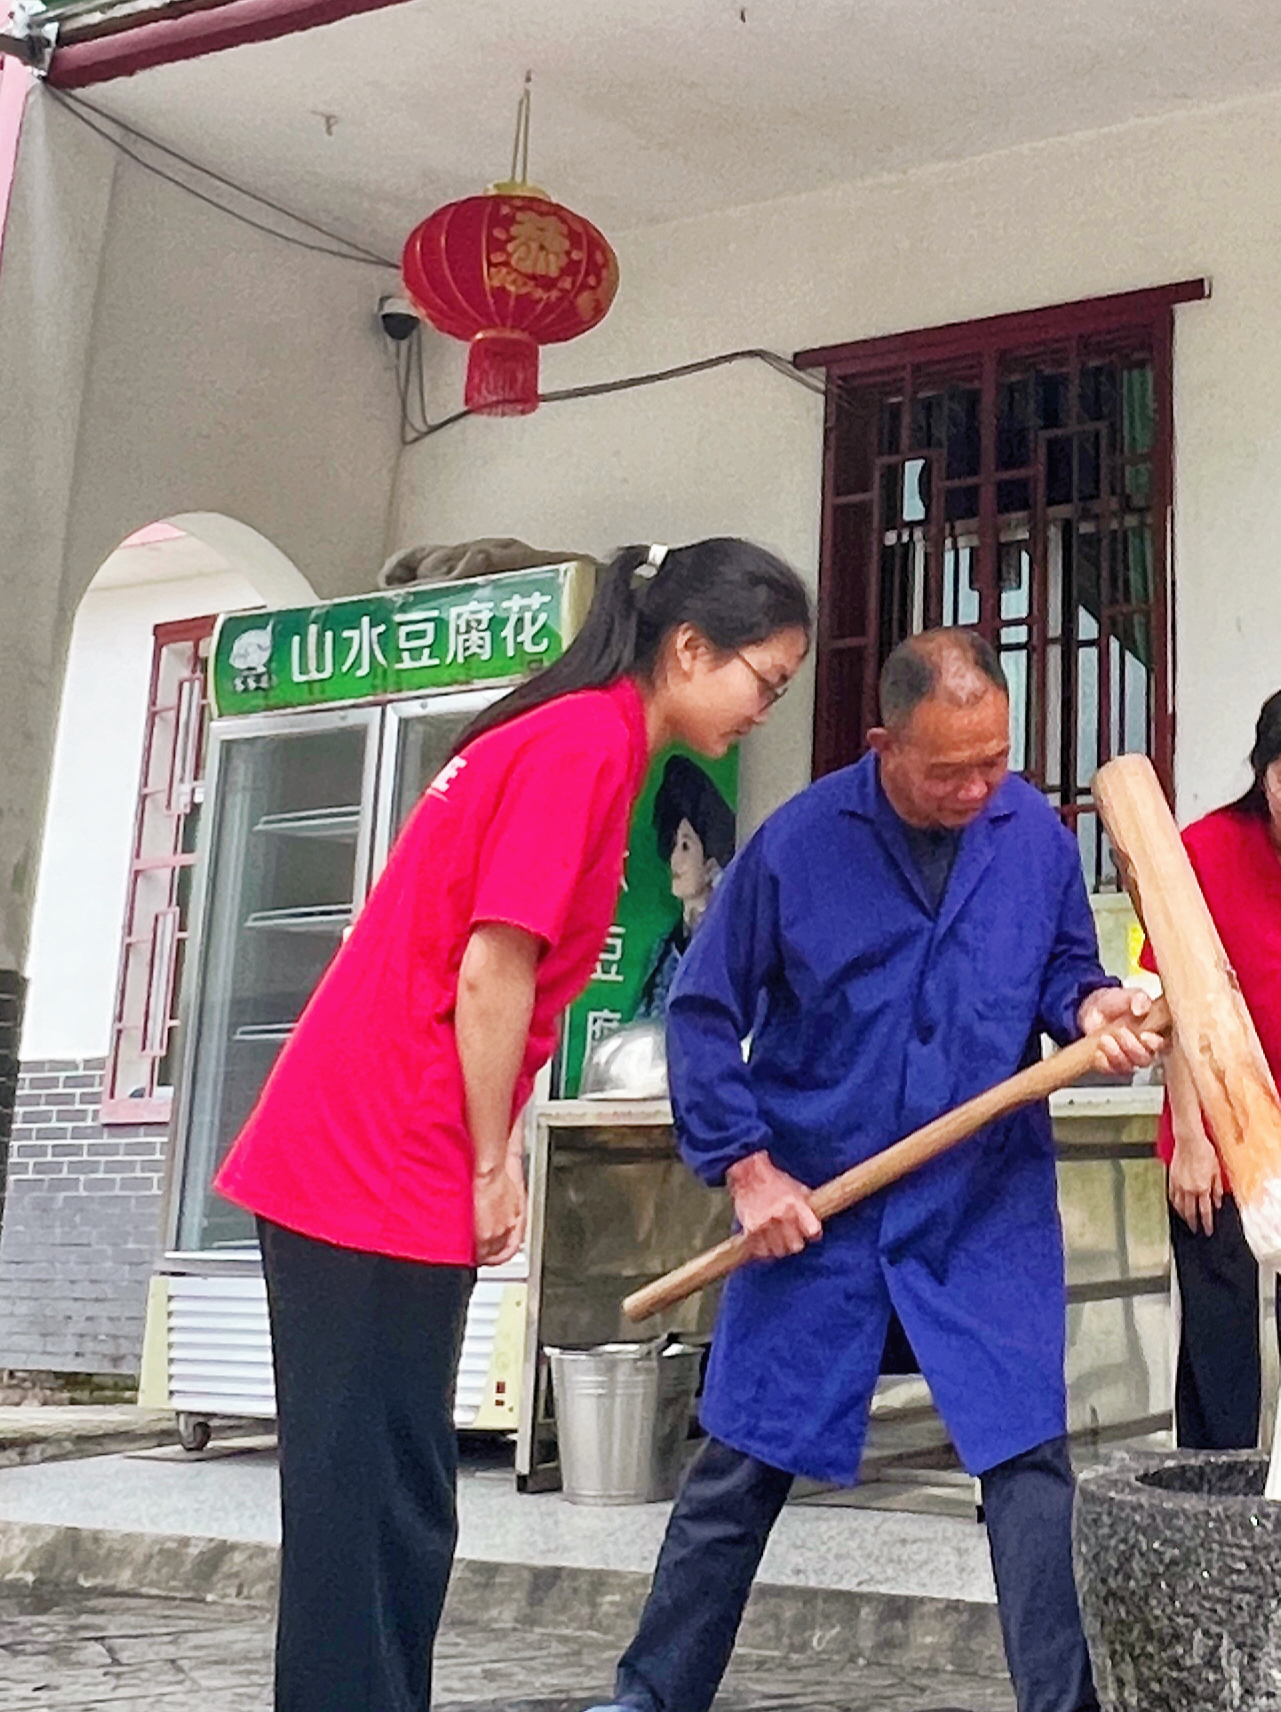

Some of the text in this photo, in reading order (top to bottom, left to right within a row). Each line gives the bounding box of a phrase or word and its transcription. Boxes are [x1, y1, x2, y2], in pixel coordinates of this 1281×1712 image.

[291, 591, 552, 683] 山水豆腐花
